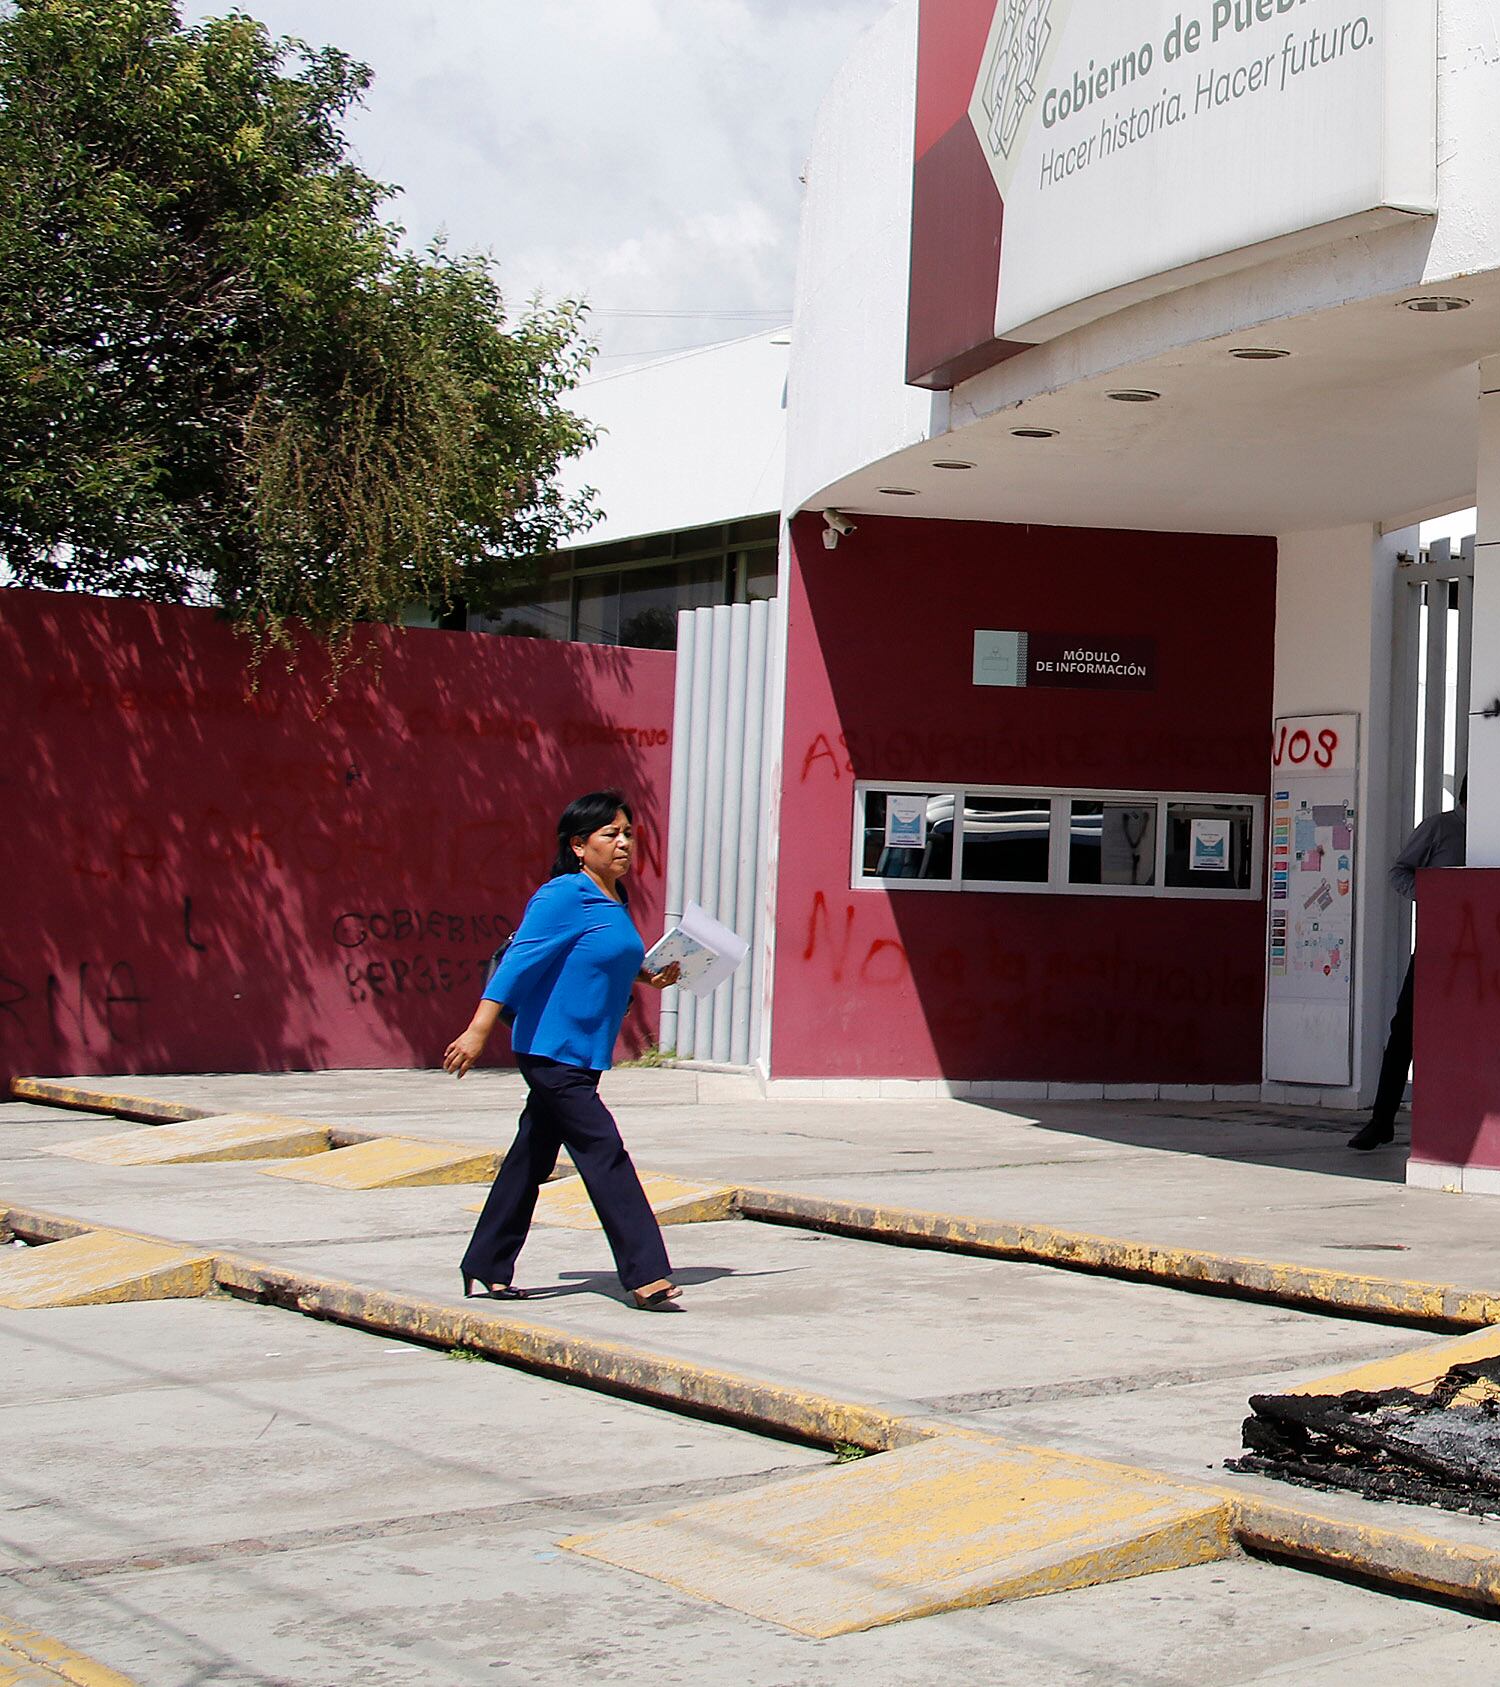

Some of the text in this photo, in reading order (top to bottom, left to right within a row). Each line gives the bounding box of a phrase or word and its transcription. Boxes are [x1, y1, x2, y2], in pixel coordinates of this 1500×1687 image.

[1039, 16, 1374, 191] Hacer historia. Hacer futuro.
[1042, 43, 1153, 129] Gobierno
[1161, 13, 1201, 65] de
[1036, 661, 1148, 676] DE INFORMACIÓN
[1062, 648, 1121, 664] MÓDULO
